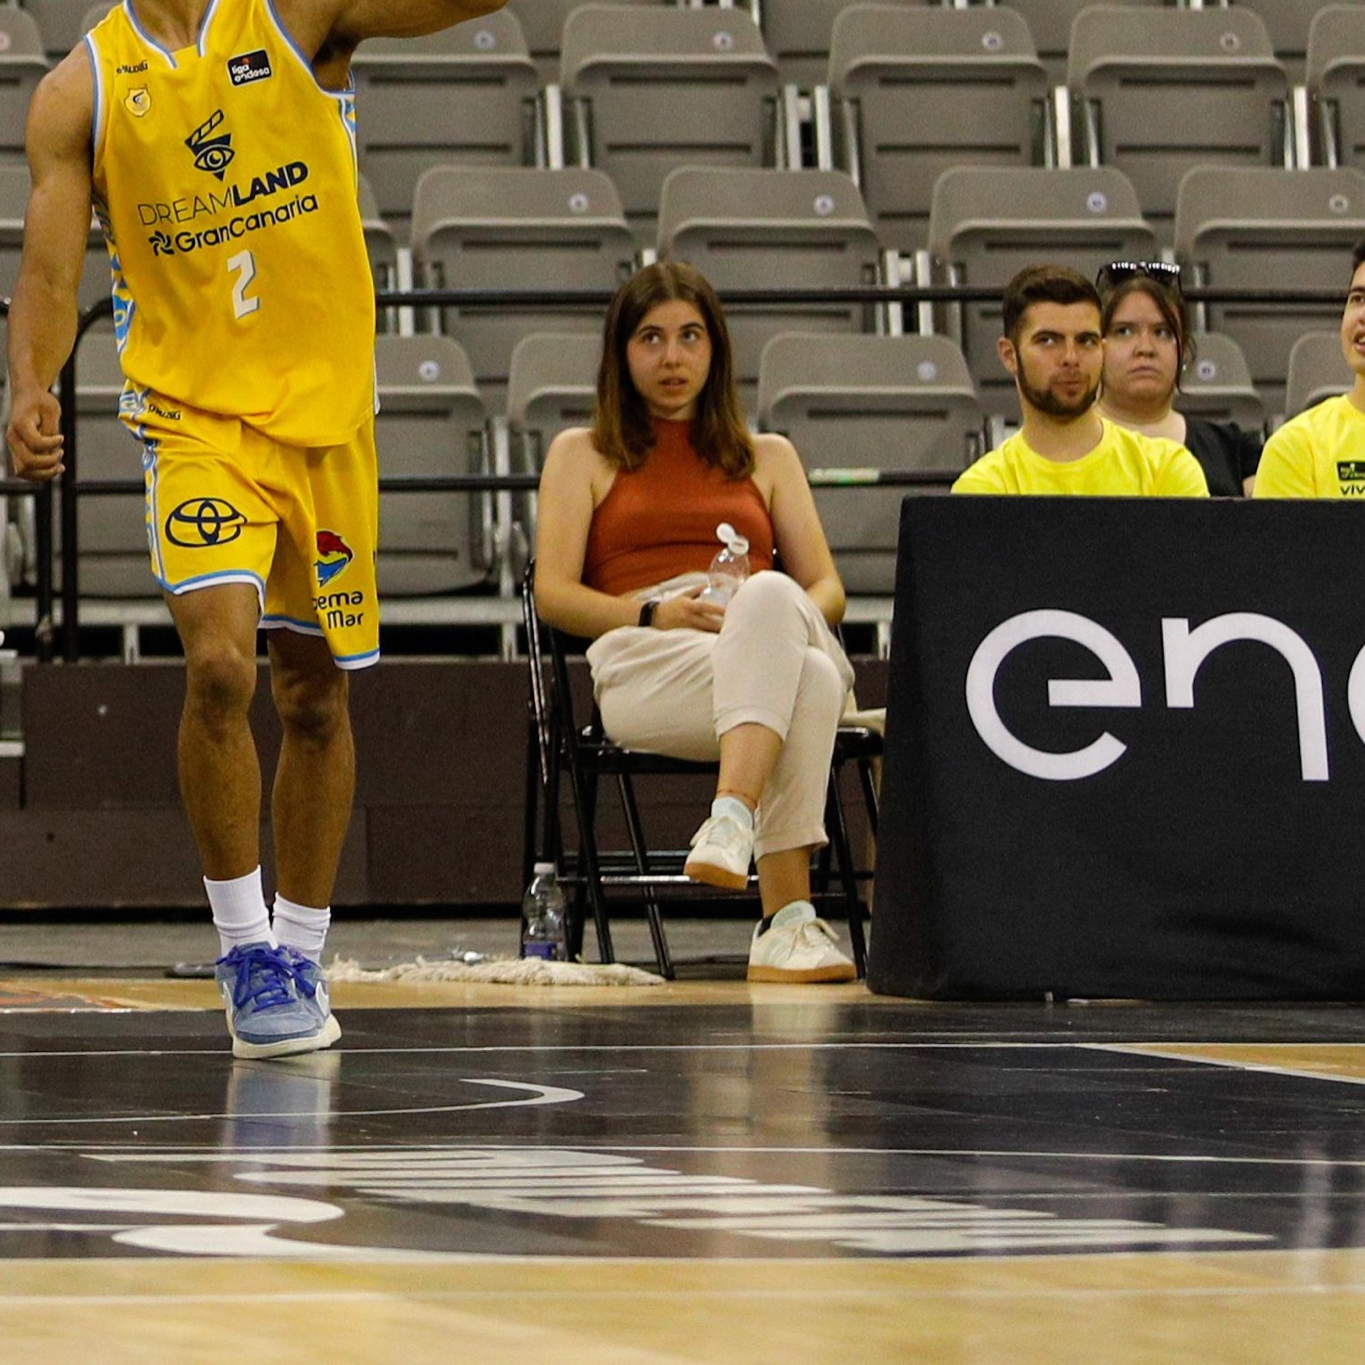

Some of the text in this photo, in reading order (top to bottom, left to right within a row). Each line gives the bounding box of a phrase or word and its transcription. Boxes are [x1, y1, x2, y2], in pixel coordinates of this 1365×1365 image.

[137, 160, 309, 227] DREAMLAND
[175, 193, 320, 253] GranCanaria
[227, 249, 260, 320] 2
[327, 610, 364, 629] Mar
[966, 609, 1365, 782] en
